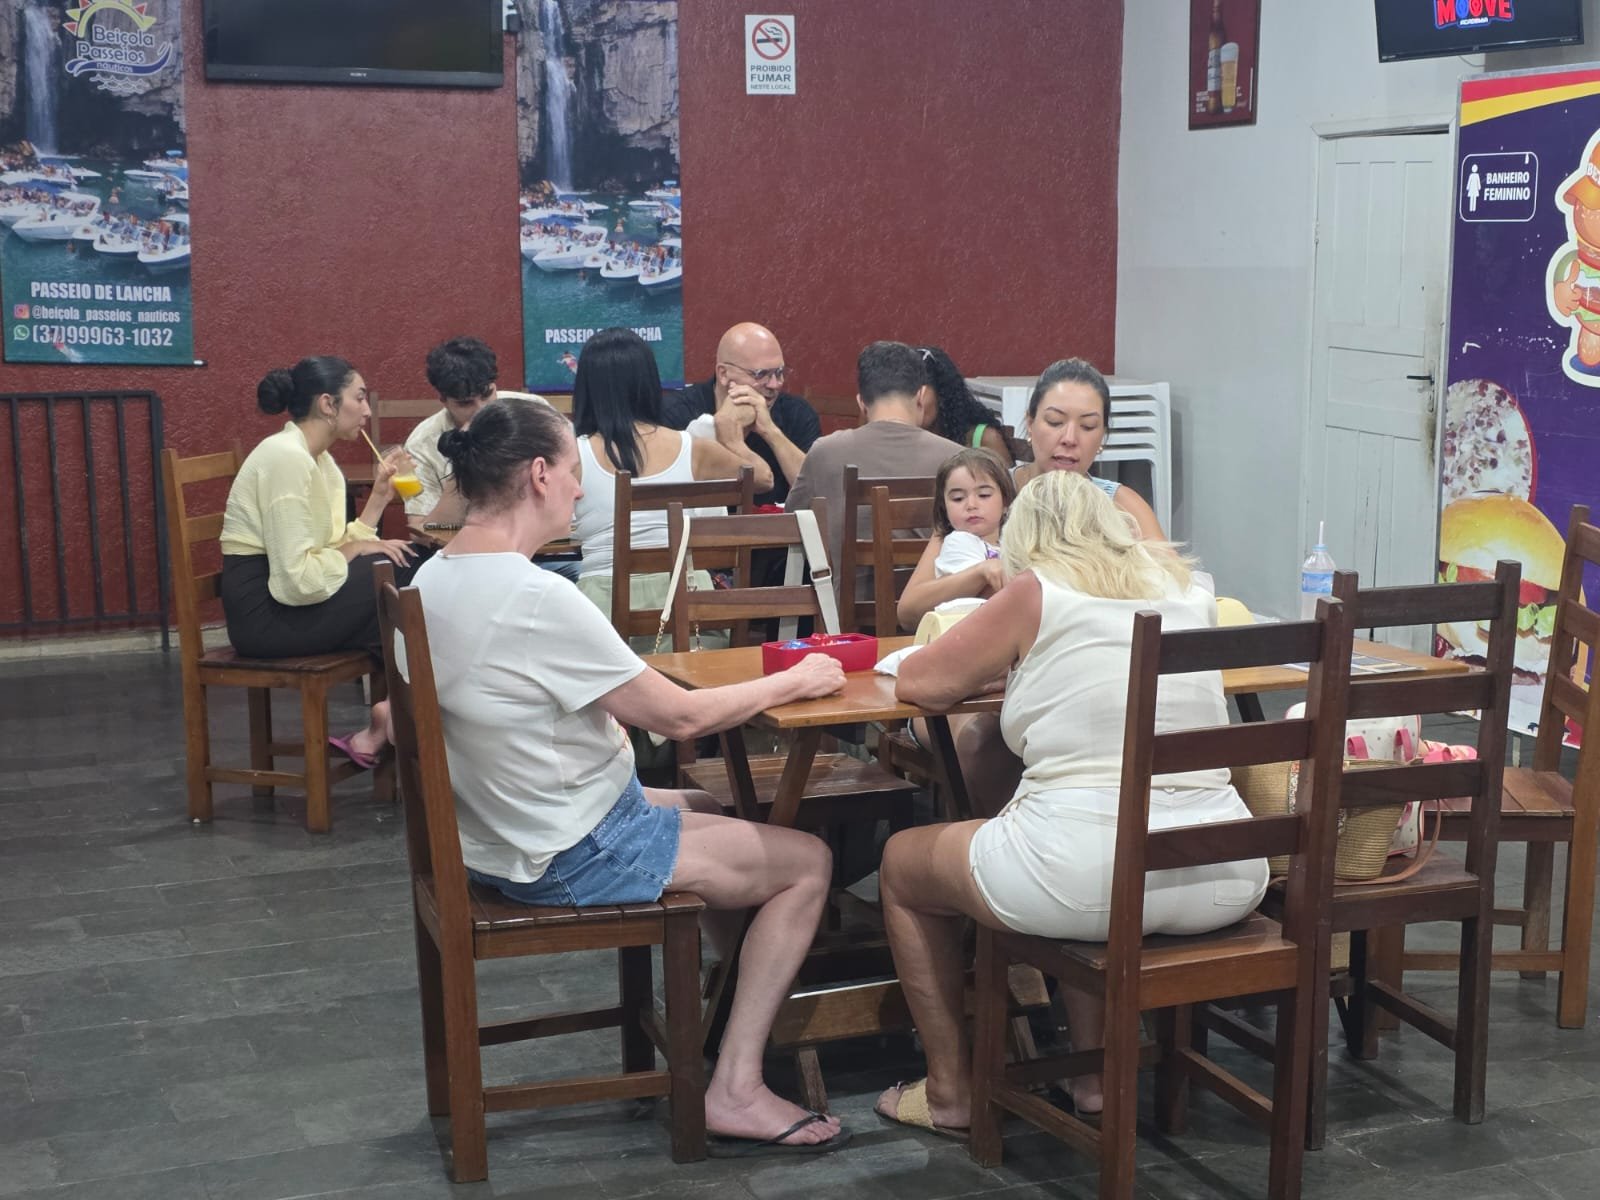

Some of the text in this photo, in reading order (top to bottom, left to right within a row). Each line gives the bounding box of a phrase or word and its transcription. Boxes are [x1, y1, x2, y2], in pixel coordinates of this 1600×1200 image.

[1437, 0, 1512, 25] MOOVE
[93, 25, 154, 46] Beiçola
[77, 42, 145, 63] Passeios
[750, 65, 792, 73] PROIBIDO
[750, 74, 792, 82] FUMAR
[1486, 171, 1530, 185] BANHEIRO
[1484, 187, 1531, 201] FEMININO
[31, 282, 172, 302] PASSEIO DE LANCHA
[33, 325, 173, 346] (37)99963-1032
